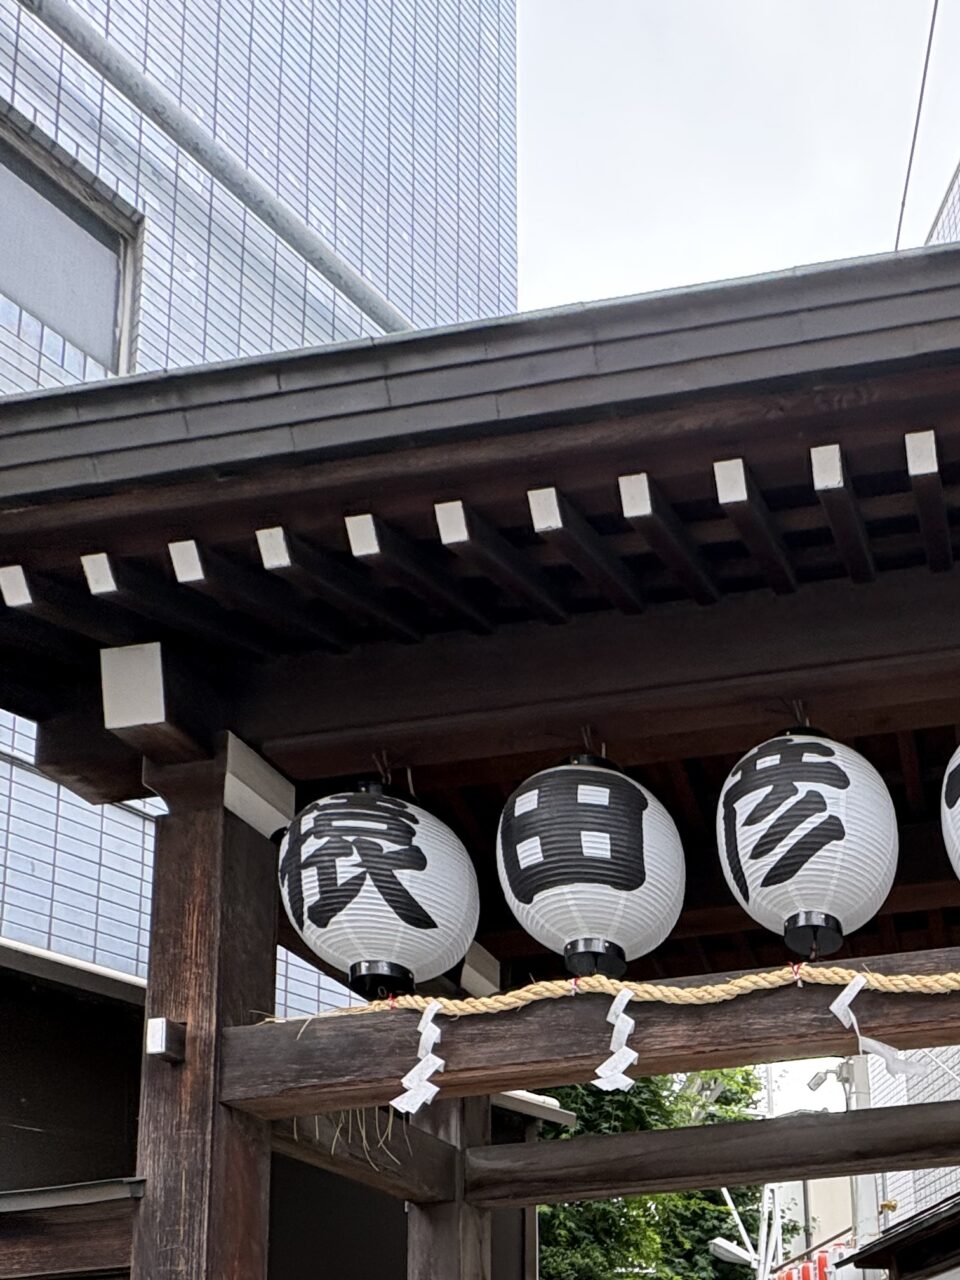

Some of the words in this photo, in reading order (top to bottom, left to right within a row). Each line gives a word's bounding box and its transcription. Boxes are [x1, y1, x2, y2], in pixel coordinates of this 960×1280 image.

[279, 792, 438, 932] 猿
[500, 767, 649, 905] 田
[723, 738, 851, 905] 彦
